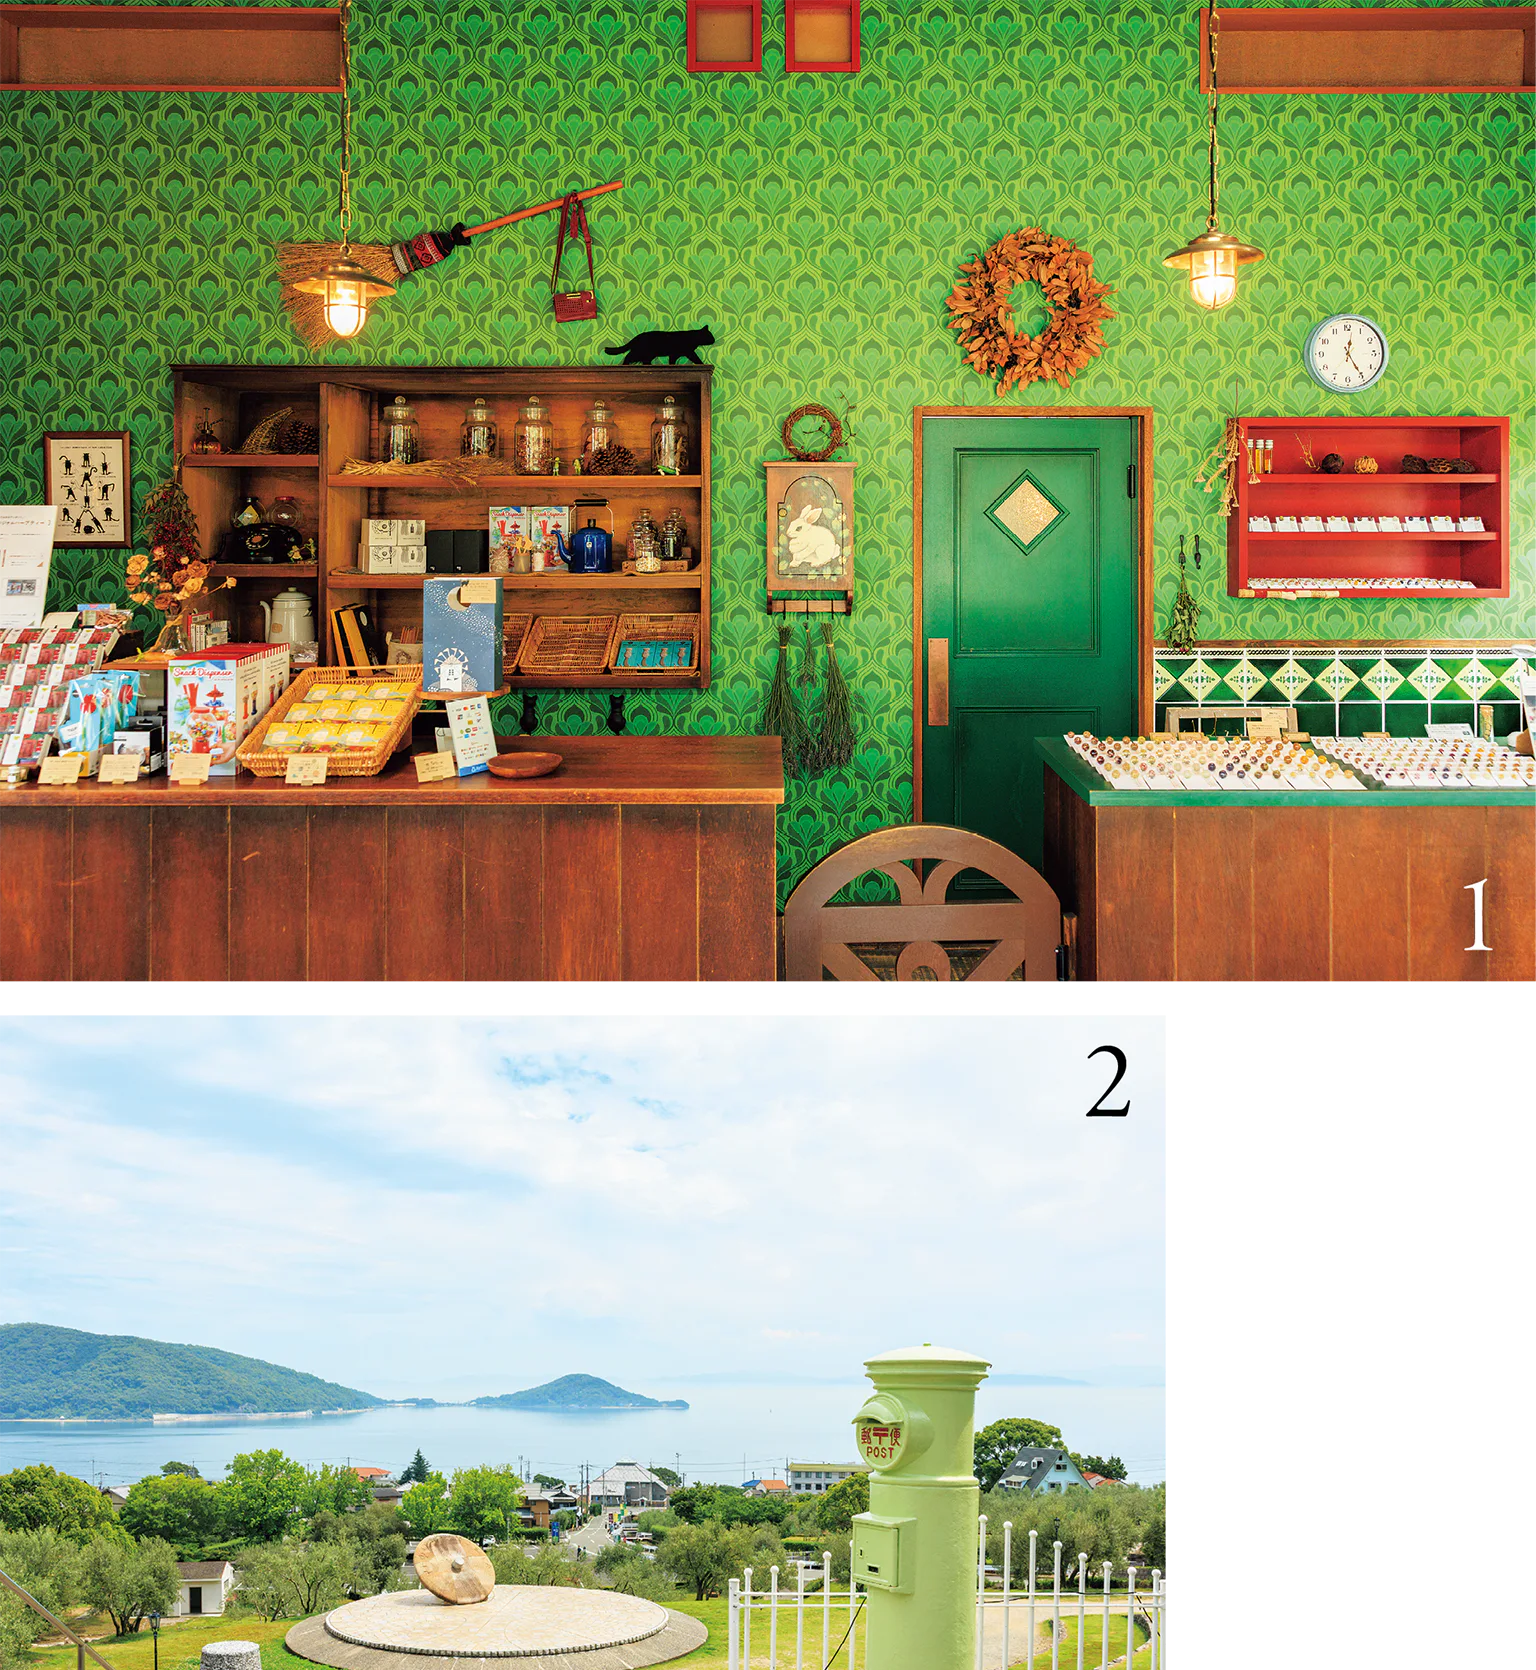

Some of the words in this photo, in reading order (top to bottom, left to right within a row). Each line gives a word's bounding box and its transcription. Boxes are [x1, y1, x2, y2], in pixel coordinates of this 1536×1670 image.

[174, 668, 196, 677] Snack
[197, 668, 233, 679] Dispenser
[866, 1446, 894, 1459] POST
